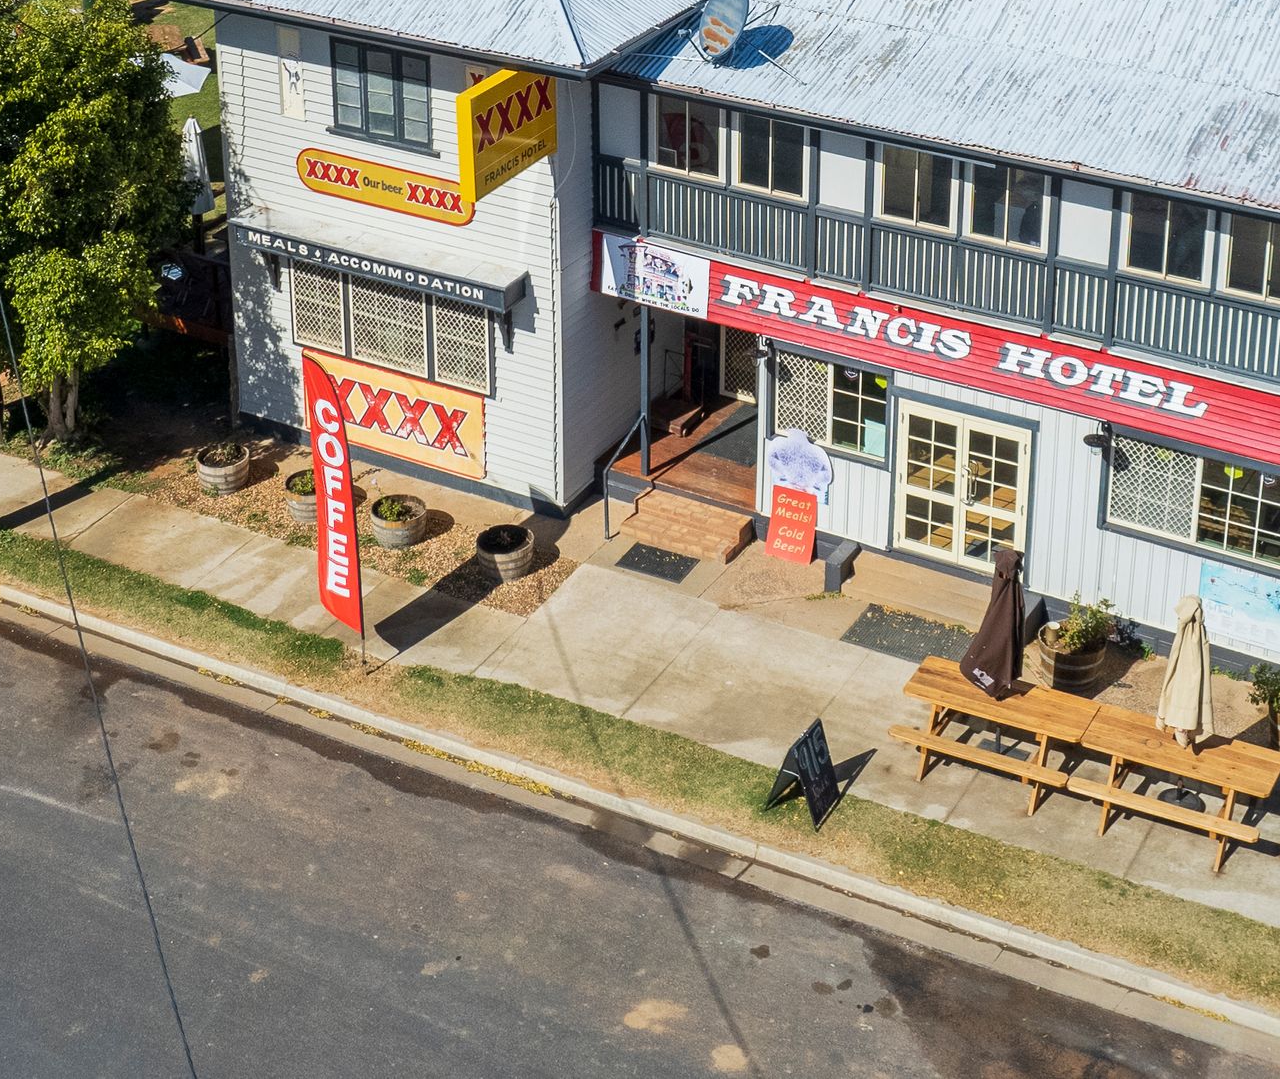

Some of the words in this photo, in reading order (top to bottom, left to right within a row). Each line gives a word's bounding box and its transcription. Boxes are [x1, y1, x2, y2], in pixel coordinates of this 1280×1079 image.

[475, 76, 553, 154] XXXX
[305, 158, 360, 189] XXXX
[363, 176, 380, 189] Our
[381, 180, 403, 195] beer.
[407, 182, 463, 214] XXXX
[484, 155, 520, 185] FRANCIS
[521, 139, 547, 163] HOTEL
[248, 231, 309, 256] MEALS
[327, 252, 484, 300] ACCOMMODATION
[719, 274, 972, 360] FRANCIS
[995, 341, 1209, 419] HOTEL
[314, 398, 351, 598] COFFEE
[775, 506, 812, 523] Meals!
[777, 493, 811, 512] Great
[773, 538, 806, 555] Beer!
[778, 526, 805, 541] Cold
